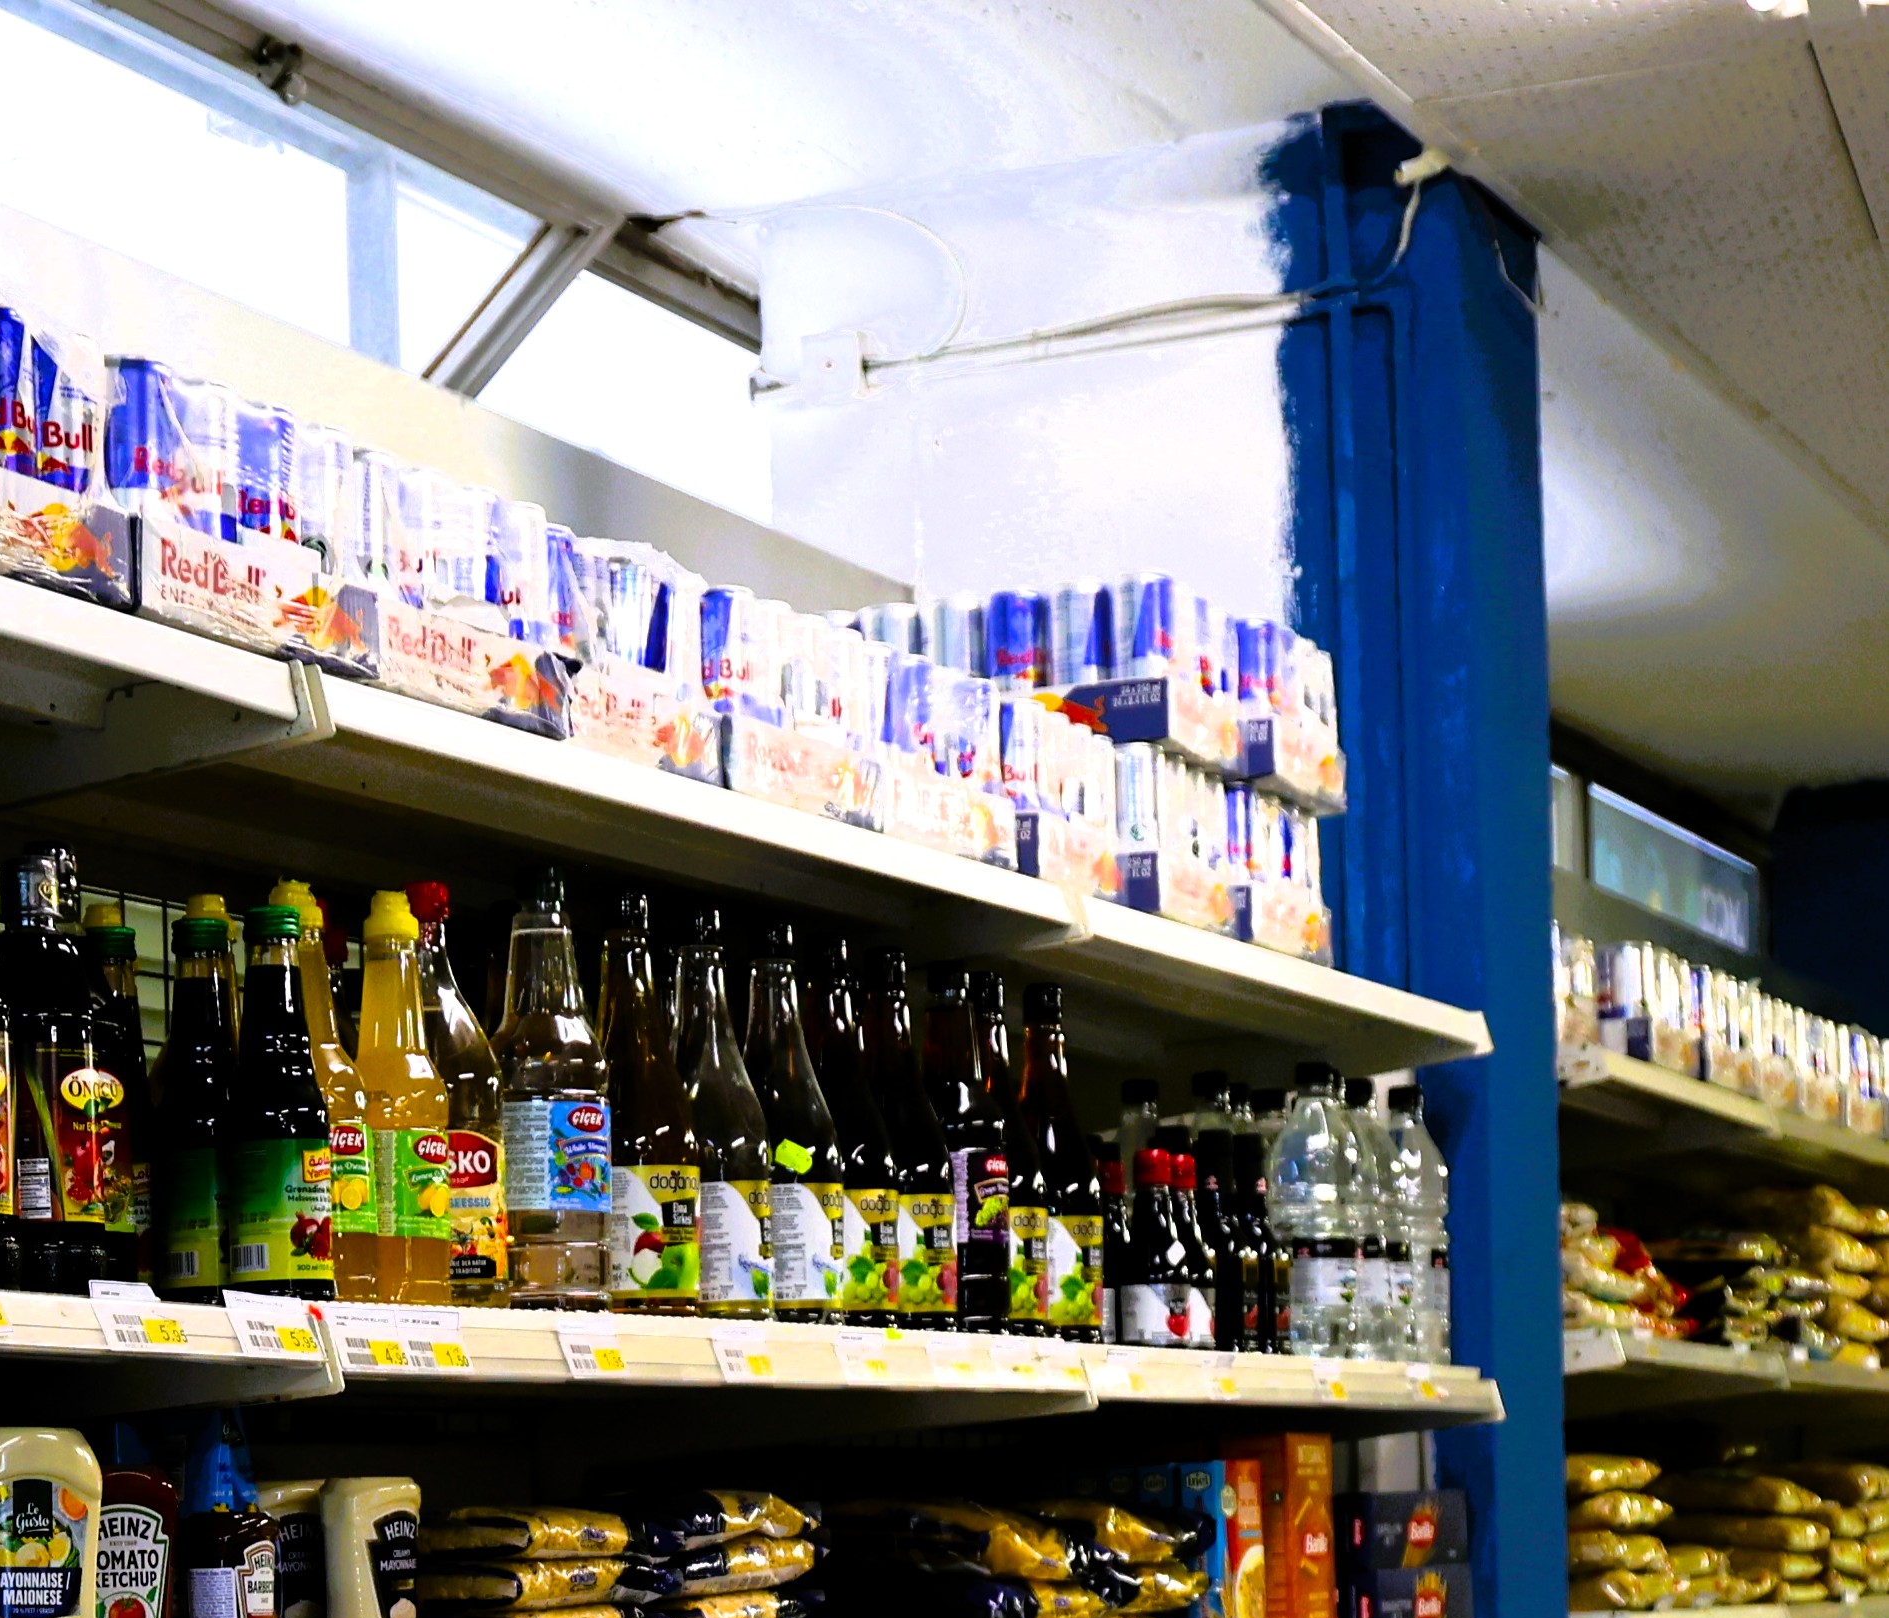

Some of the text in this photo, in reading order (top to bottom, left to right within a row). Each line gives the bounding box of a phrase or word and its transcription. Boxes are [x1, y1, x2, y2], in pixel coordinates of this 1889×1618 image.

[43, 421, 93, 453] Bull
[160, 538, 209, 589] Red
[571, 1109, 604, 1127] ÇİÇEK
[159, 1324, 188, 1343] 5.95
[290, 1331, 317, 1349] 5.95
[15, 1513, 51, 1534] Gusto
[97, 1548, 159, 1570] OMATO
[3, 1588, 63, 1606] MAIONESE
